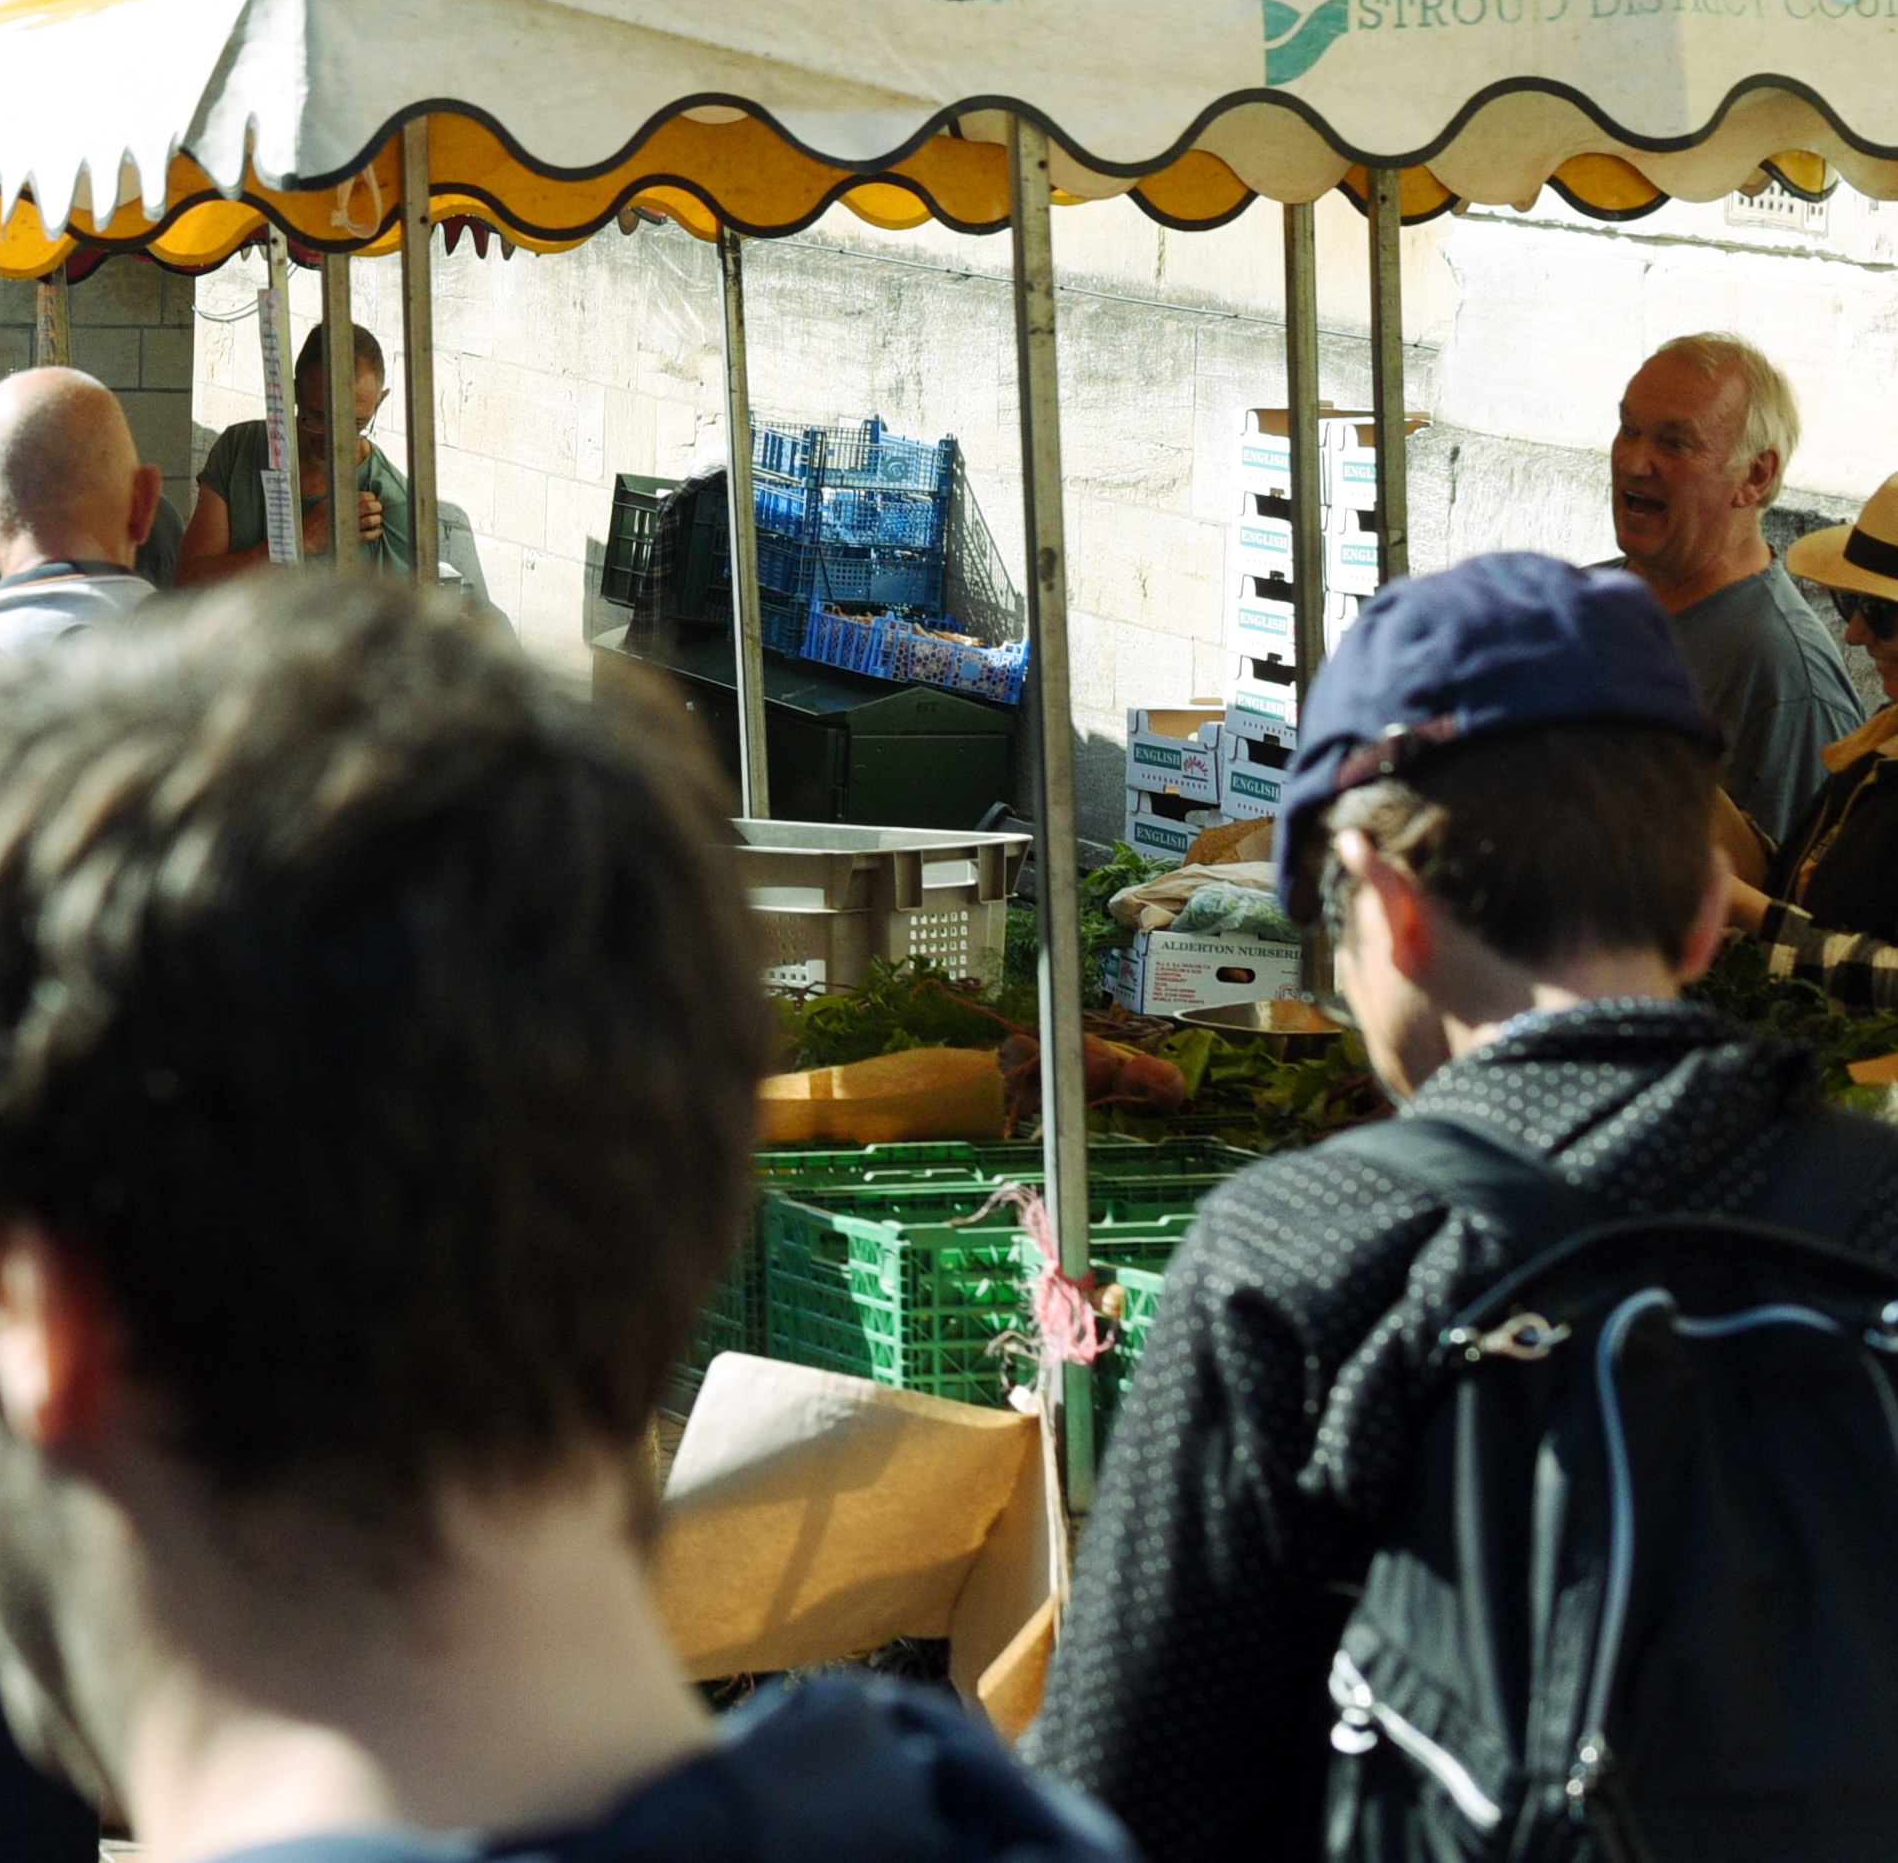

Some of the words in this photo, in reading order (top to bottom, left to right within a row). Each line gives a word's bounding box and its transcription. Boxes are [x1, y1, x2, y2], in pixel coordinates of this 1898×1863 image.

[1240, 529, 1288, 551] ENGLISH
[1239, 611, 1287, 633] ENGLISH
[1236, 693, 1285, 717] ENGLISH
[1135, 746, 1181, 767] ENGLISH
[1232, 775, 1280, 800] ENGLISH
[1136, 826, 1187, 850] ENGLISH
[1161, 940, 1235, 956] ALDERTON
